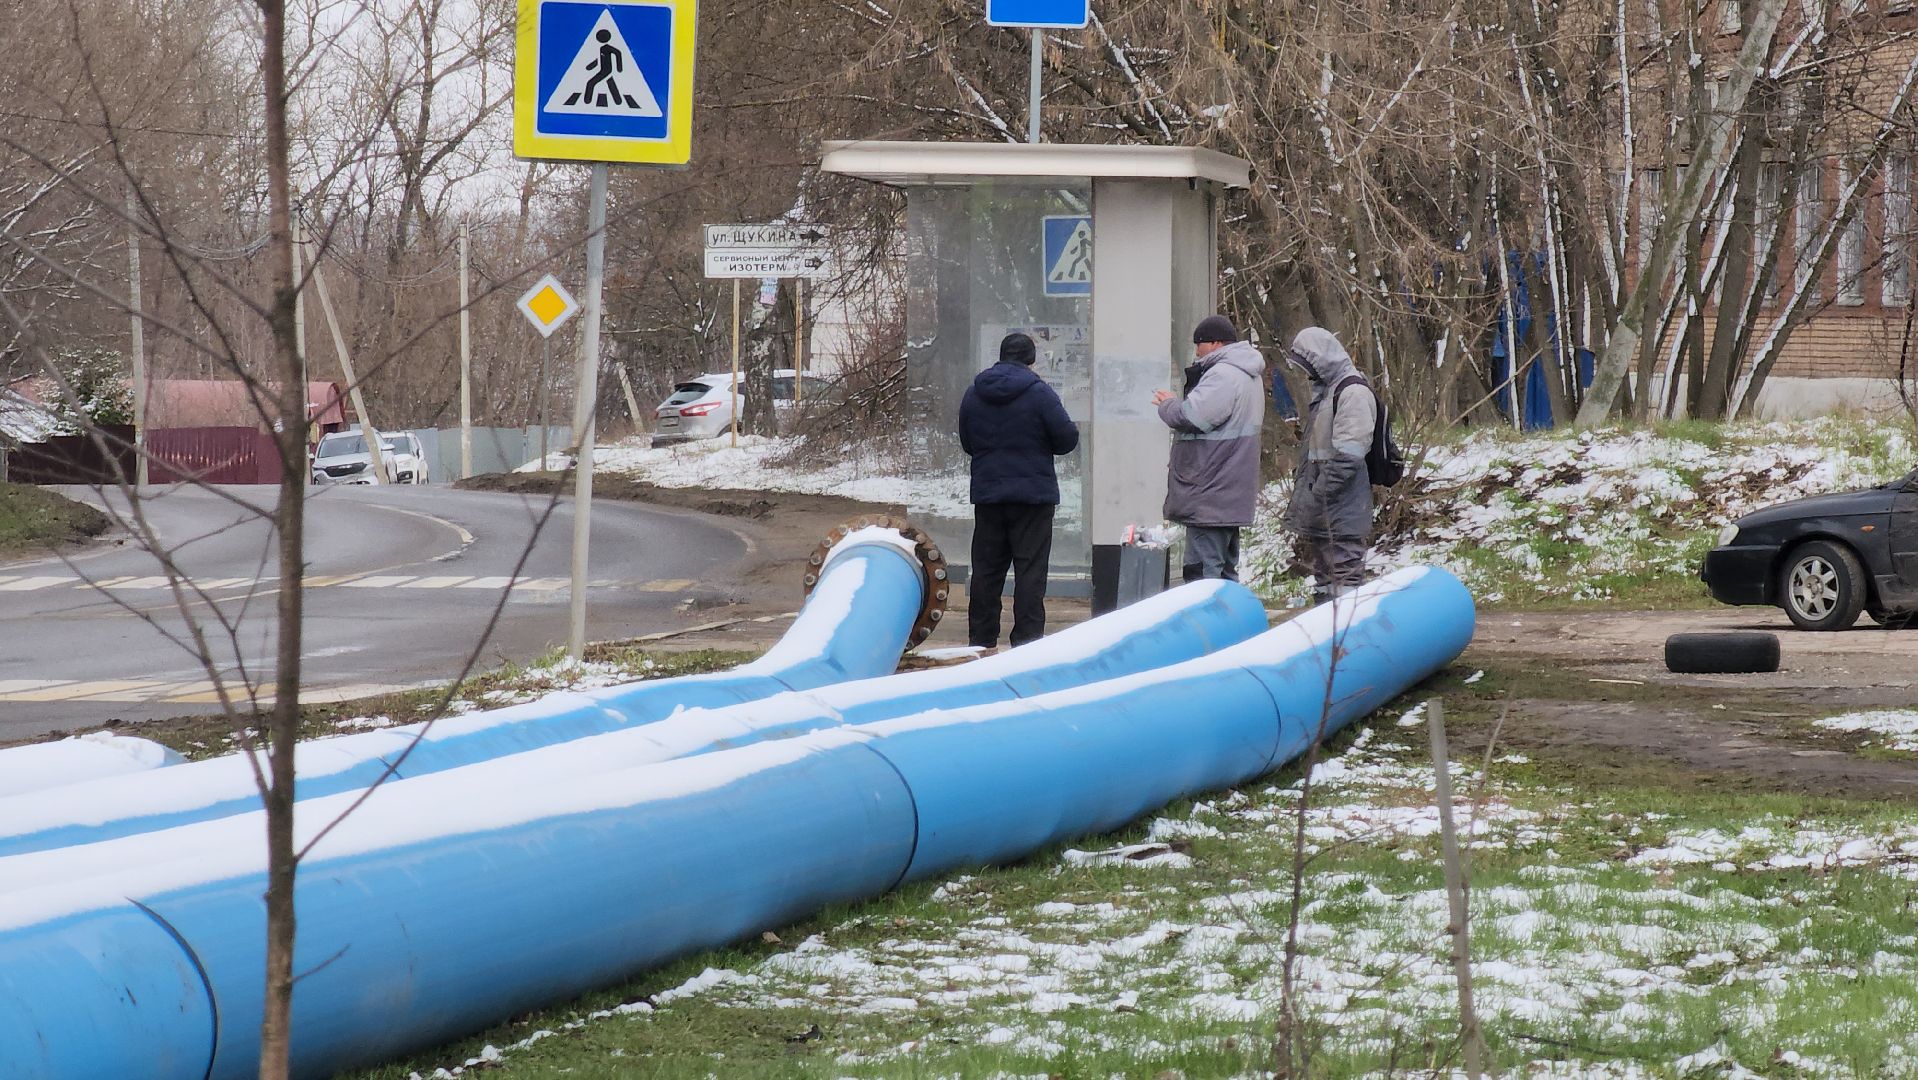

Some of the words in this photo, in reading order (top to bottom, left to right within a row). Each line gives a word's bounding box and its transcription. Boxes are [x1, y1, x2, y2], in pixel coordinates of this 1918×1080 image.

[711, 234, 730, 246] ул.
[733, 231, 797, 244] ЩУКИНА
[712, 255, 769, 263] СЕРВИСНЫЙ
